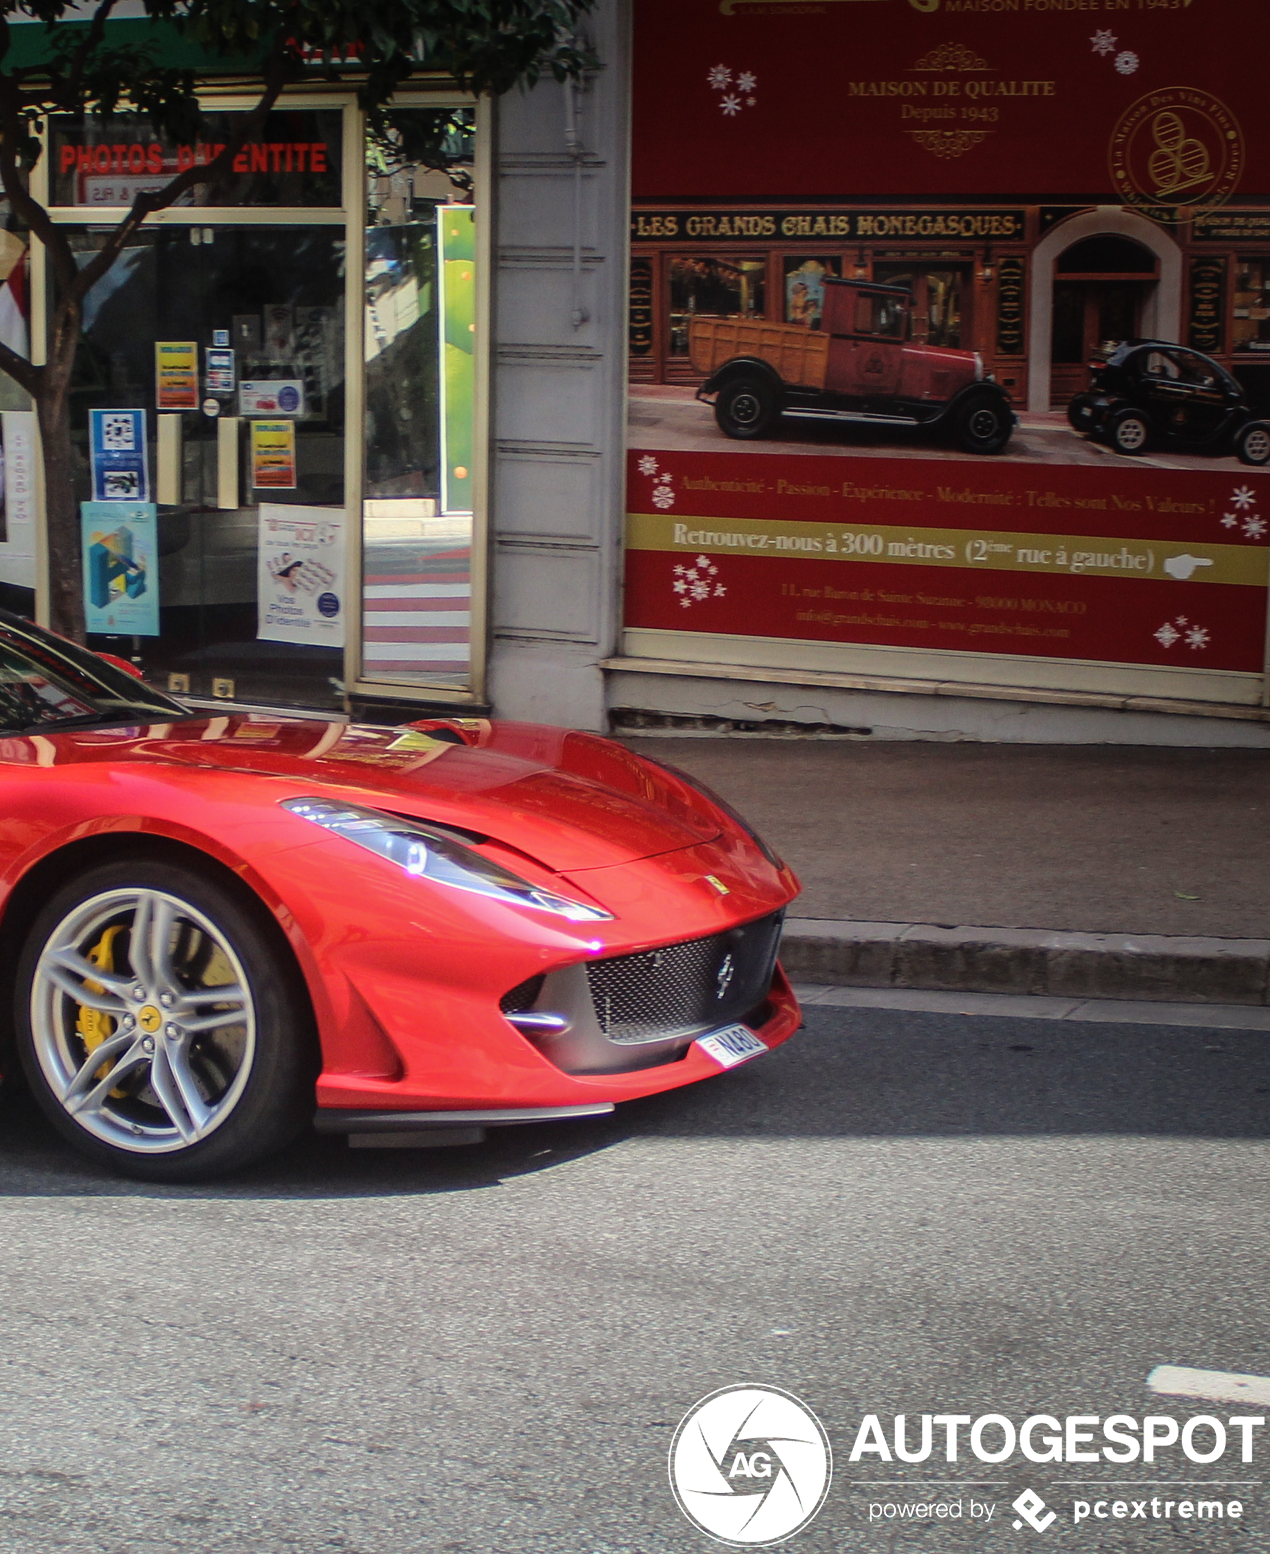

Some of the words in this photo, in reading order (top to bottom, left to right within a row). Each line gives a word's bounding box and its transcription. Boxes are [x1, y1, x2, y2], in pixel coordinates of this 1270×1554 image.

[945, 0, 1018, 11] MAISON
[1104, 0, 1133, 10] EN
[1138, 0, 1178, 9] 1943
[848, 81, 928, 96] MAISON
[933, 81, 960, 96] DE
[965, 81, 1056, 99] QUALITE
[901, 103, 957, 123] Depuis
[961, 106, 999, 122] 1943
[60, 143, 163, 174] PHOTOS
[636, 216, 678, 236] LES
[685, 216, 775, 236] GRANDS
[781, 216, 850, 236] CHAIS
[856, 216, 1013, 236] MONEGASQUES
[681, 475, 765, 494] Authenticité
[777, 479, 830, 497] Passion
[842, 482, 924, 503] Expérience
[937, 486, 1014, 506] Modernité
[1025, 490, 1072, 509] Telles
[1074, 495, 1107, 510] sont
[1110, 494, 1142, 511] Nos
[1145, 495, 1205, 514] Valeurs
[674, 523, 822, 551] Retrouvez-nous
[826, 533, 838, 553] à
[841, 532, 883, 555] 300
[888, 537, 956, 560] mètres
[1016, 547, 1052, 564] rue
[1055, 545, 1068, 566] à
[1069, 546, 1155, 574] gauche)
[1020, 598, 1087, 614] MONACO
